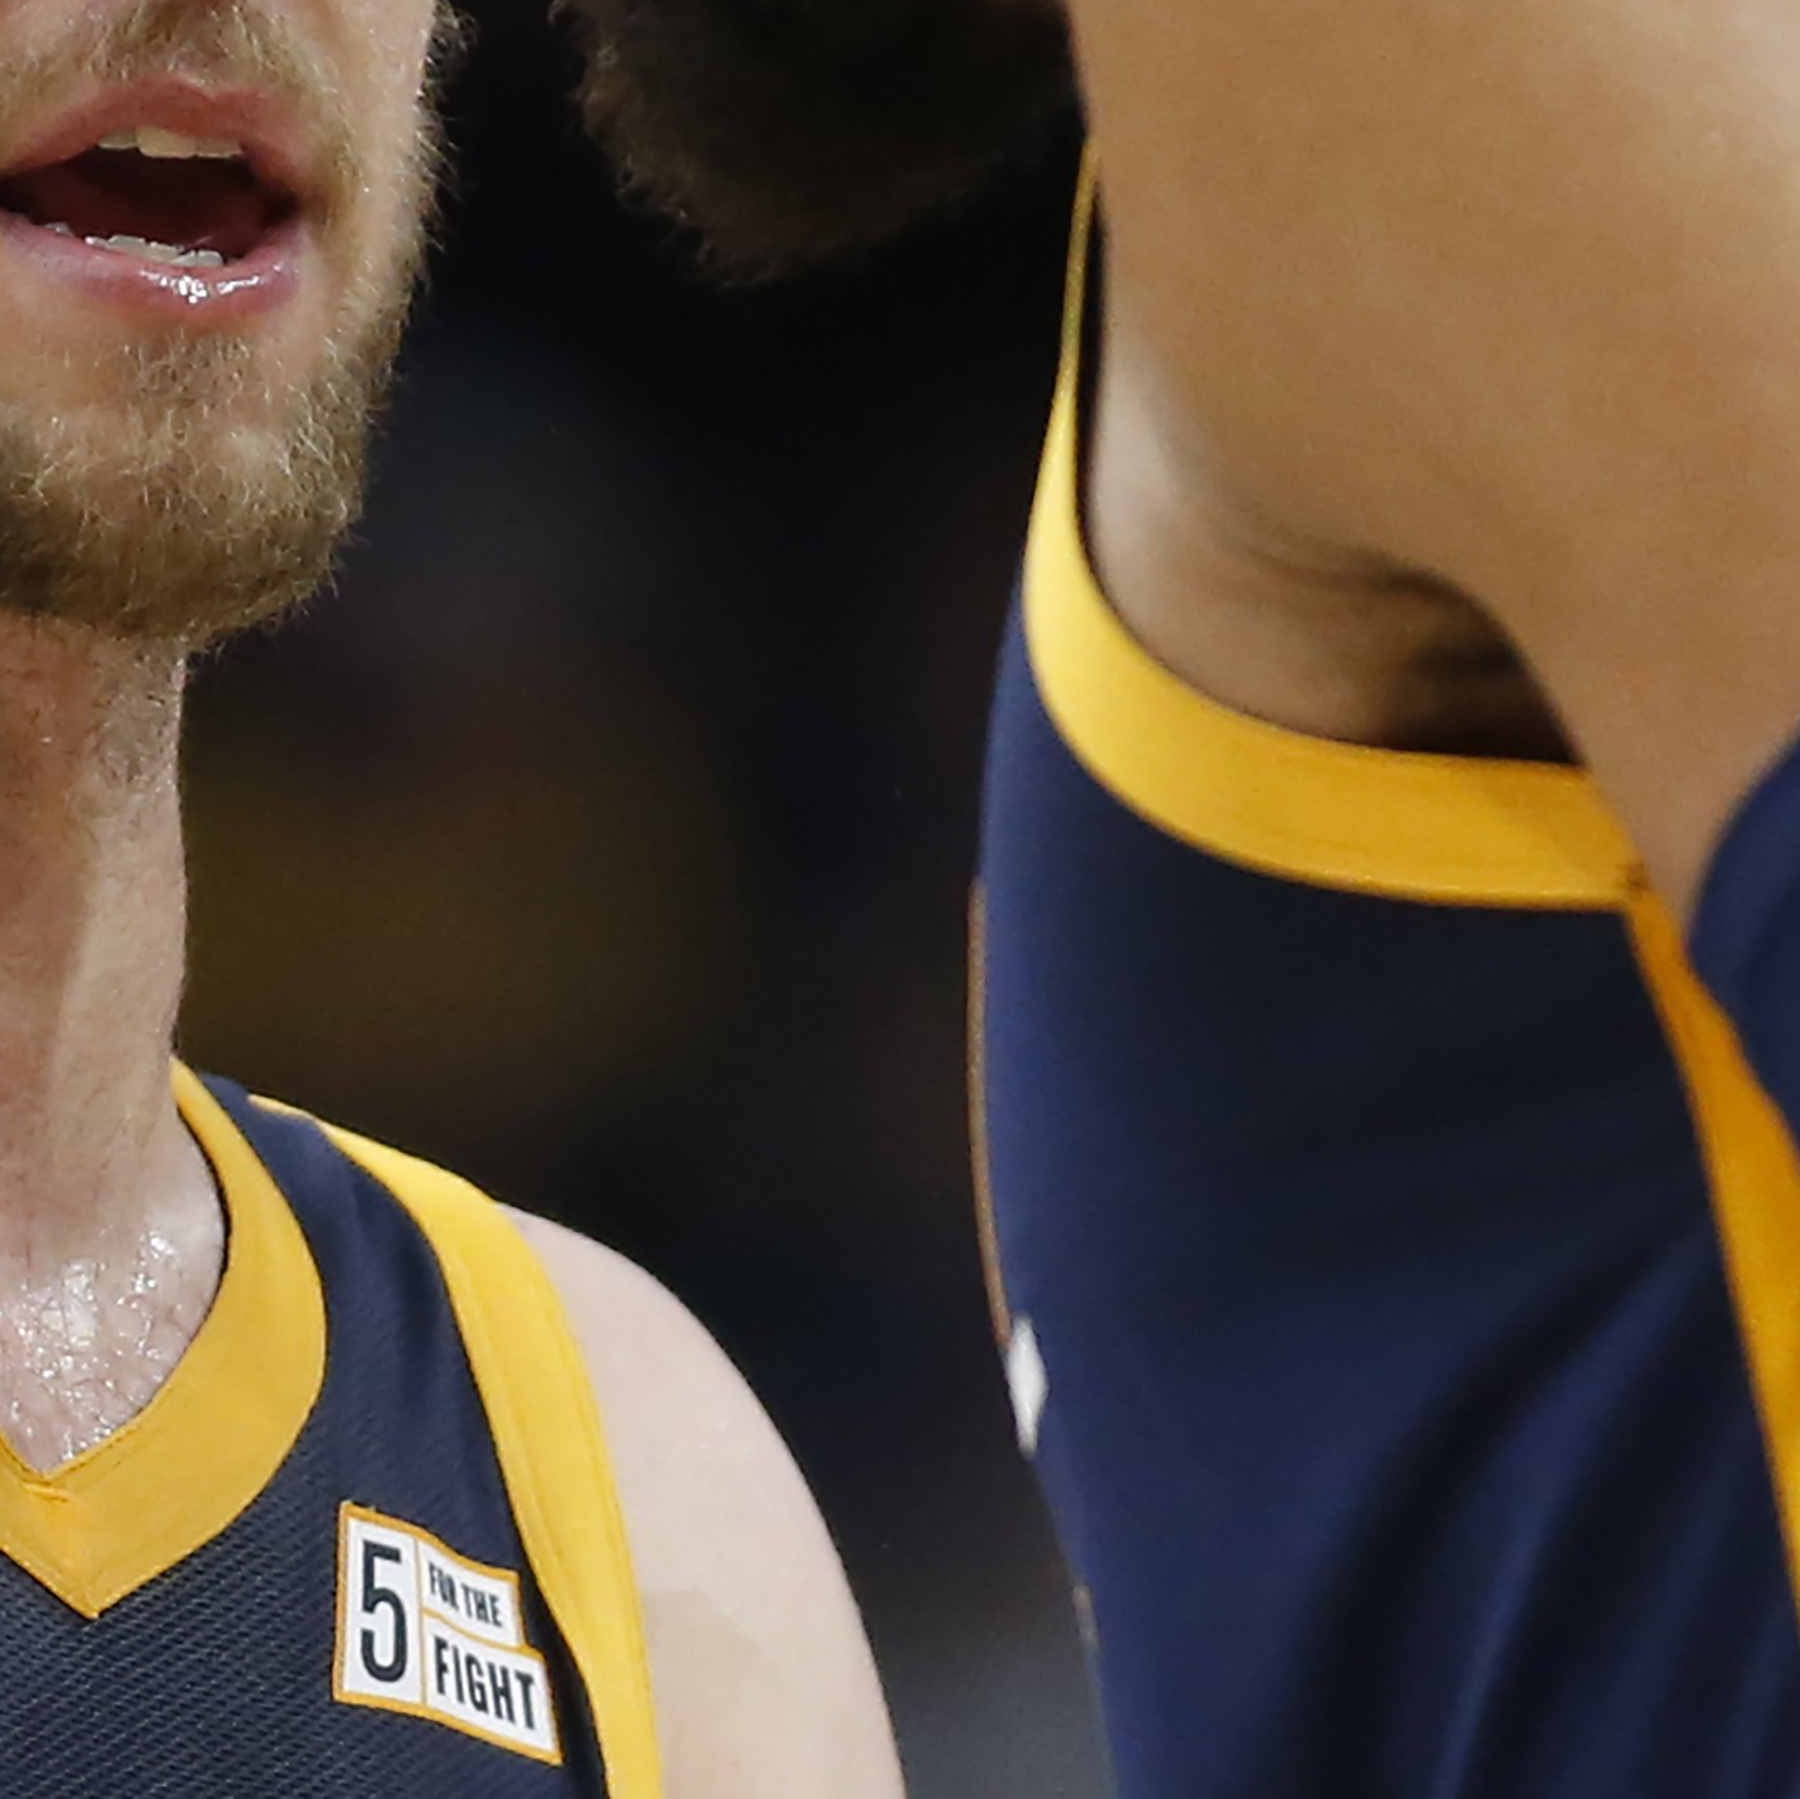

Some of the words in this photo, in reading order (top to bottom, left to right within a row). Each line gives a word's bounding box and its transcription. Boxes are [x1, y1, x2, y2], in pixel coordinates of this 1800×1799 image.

[360, 1538, 408, 1683] 5
[461, 1583, 503, 1628] THE
[434, 1635, 536, 1730] FIGHT
